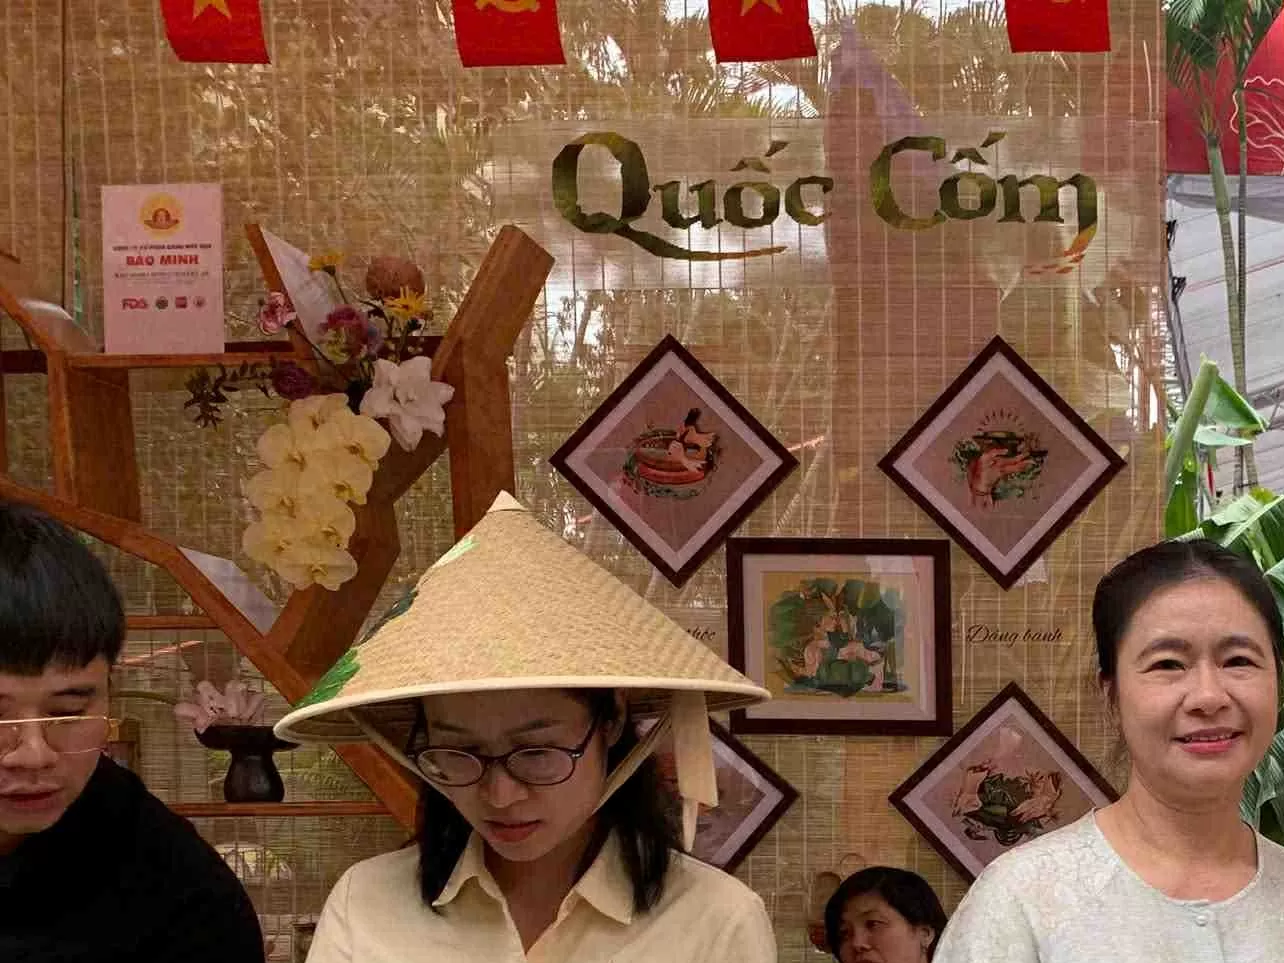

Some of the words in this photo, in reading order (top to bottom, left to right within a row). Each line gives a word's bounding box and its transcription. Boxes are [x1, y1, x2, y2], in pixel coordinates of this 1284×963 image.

[552, 132, 834, 262] Quốc
[870, 131, 1098, 275] Cốm
[160, 255, 200, 265] MINH
